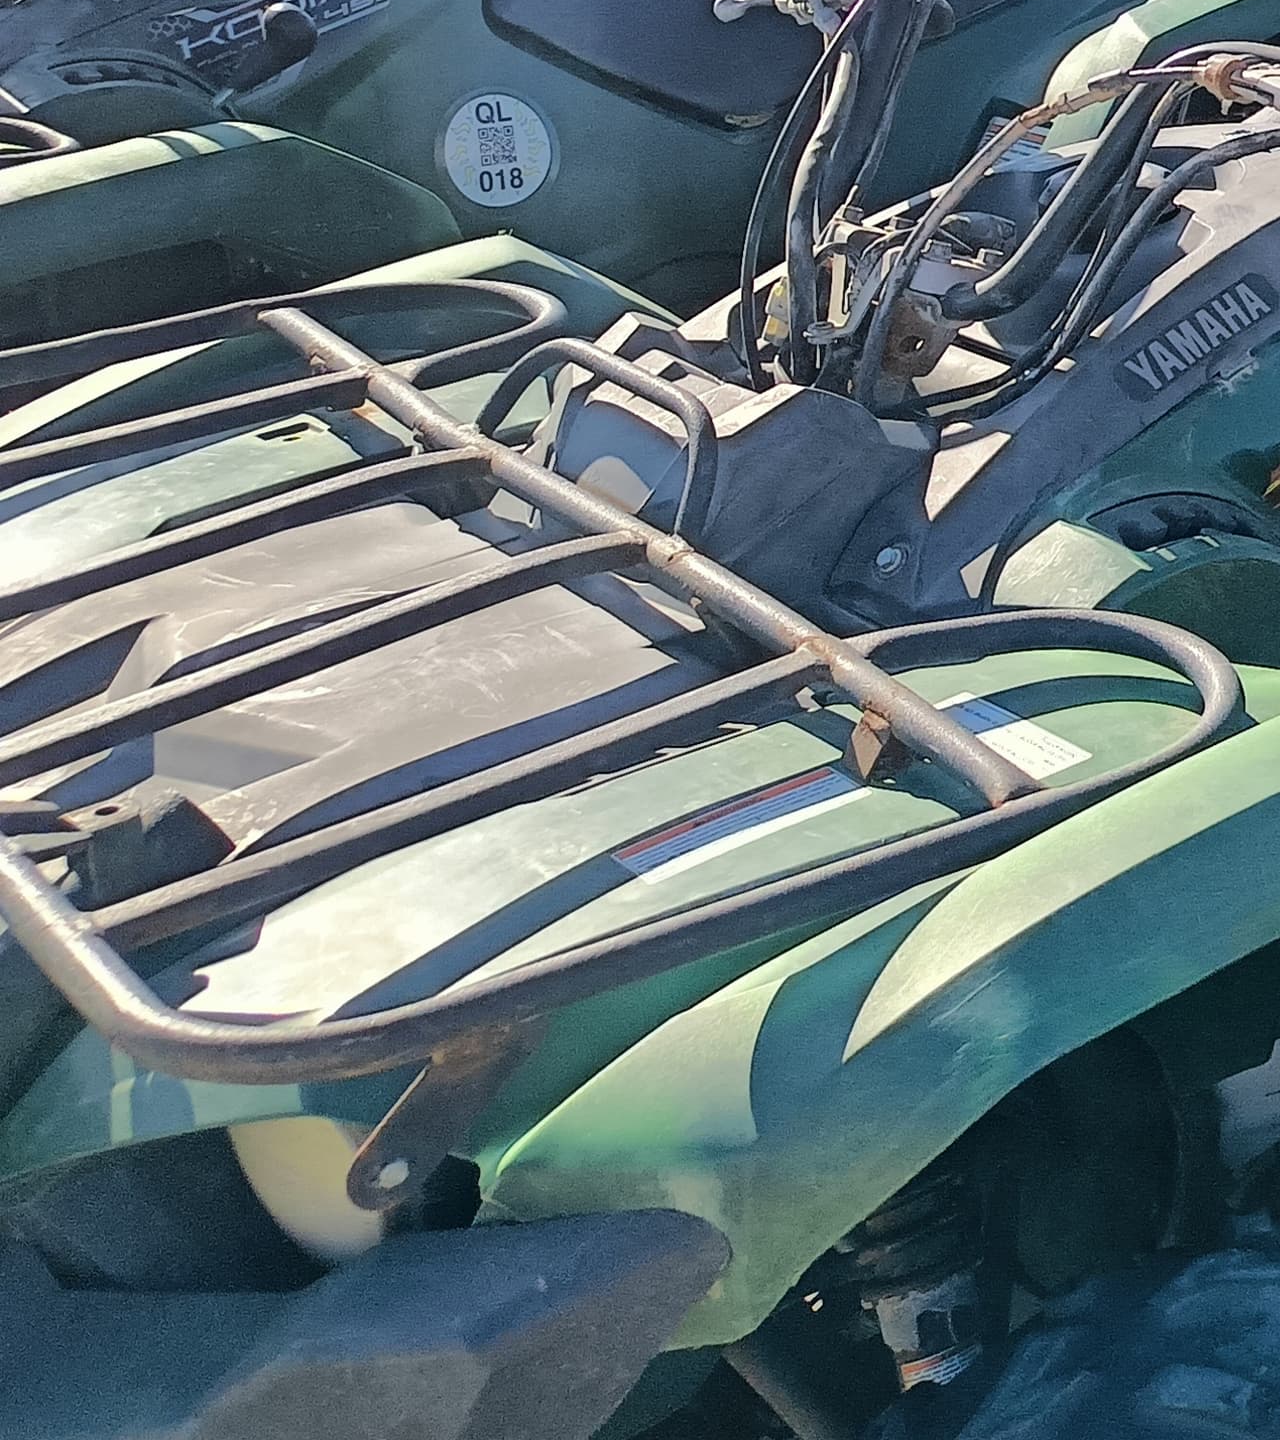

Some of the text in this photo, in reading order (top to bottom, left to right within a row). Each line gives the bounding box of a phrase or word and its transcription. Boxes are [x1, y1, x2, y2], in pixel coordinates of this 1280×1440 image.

[475, 101, 513, 124] QL
[479, 167, 524, 192] 018
[1124, 283, 1271, 390] YAMAHA
